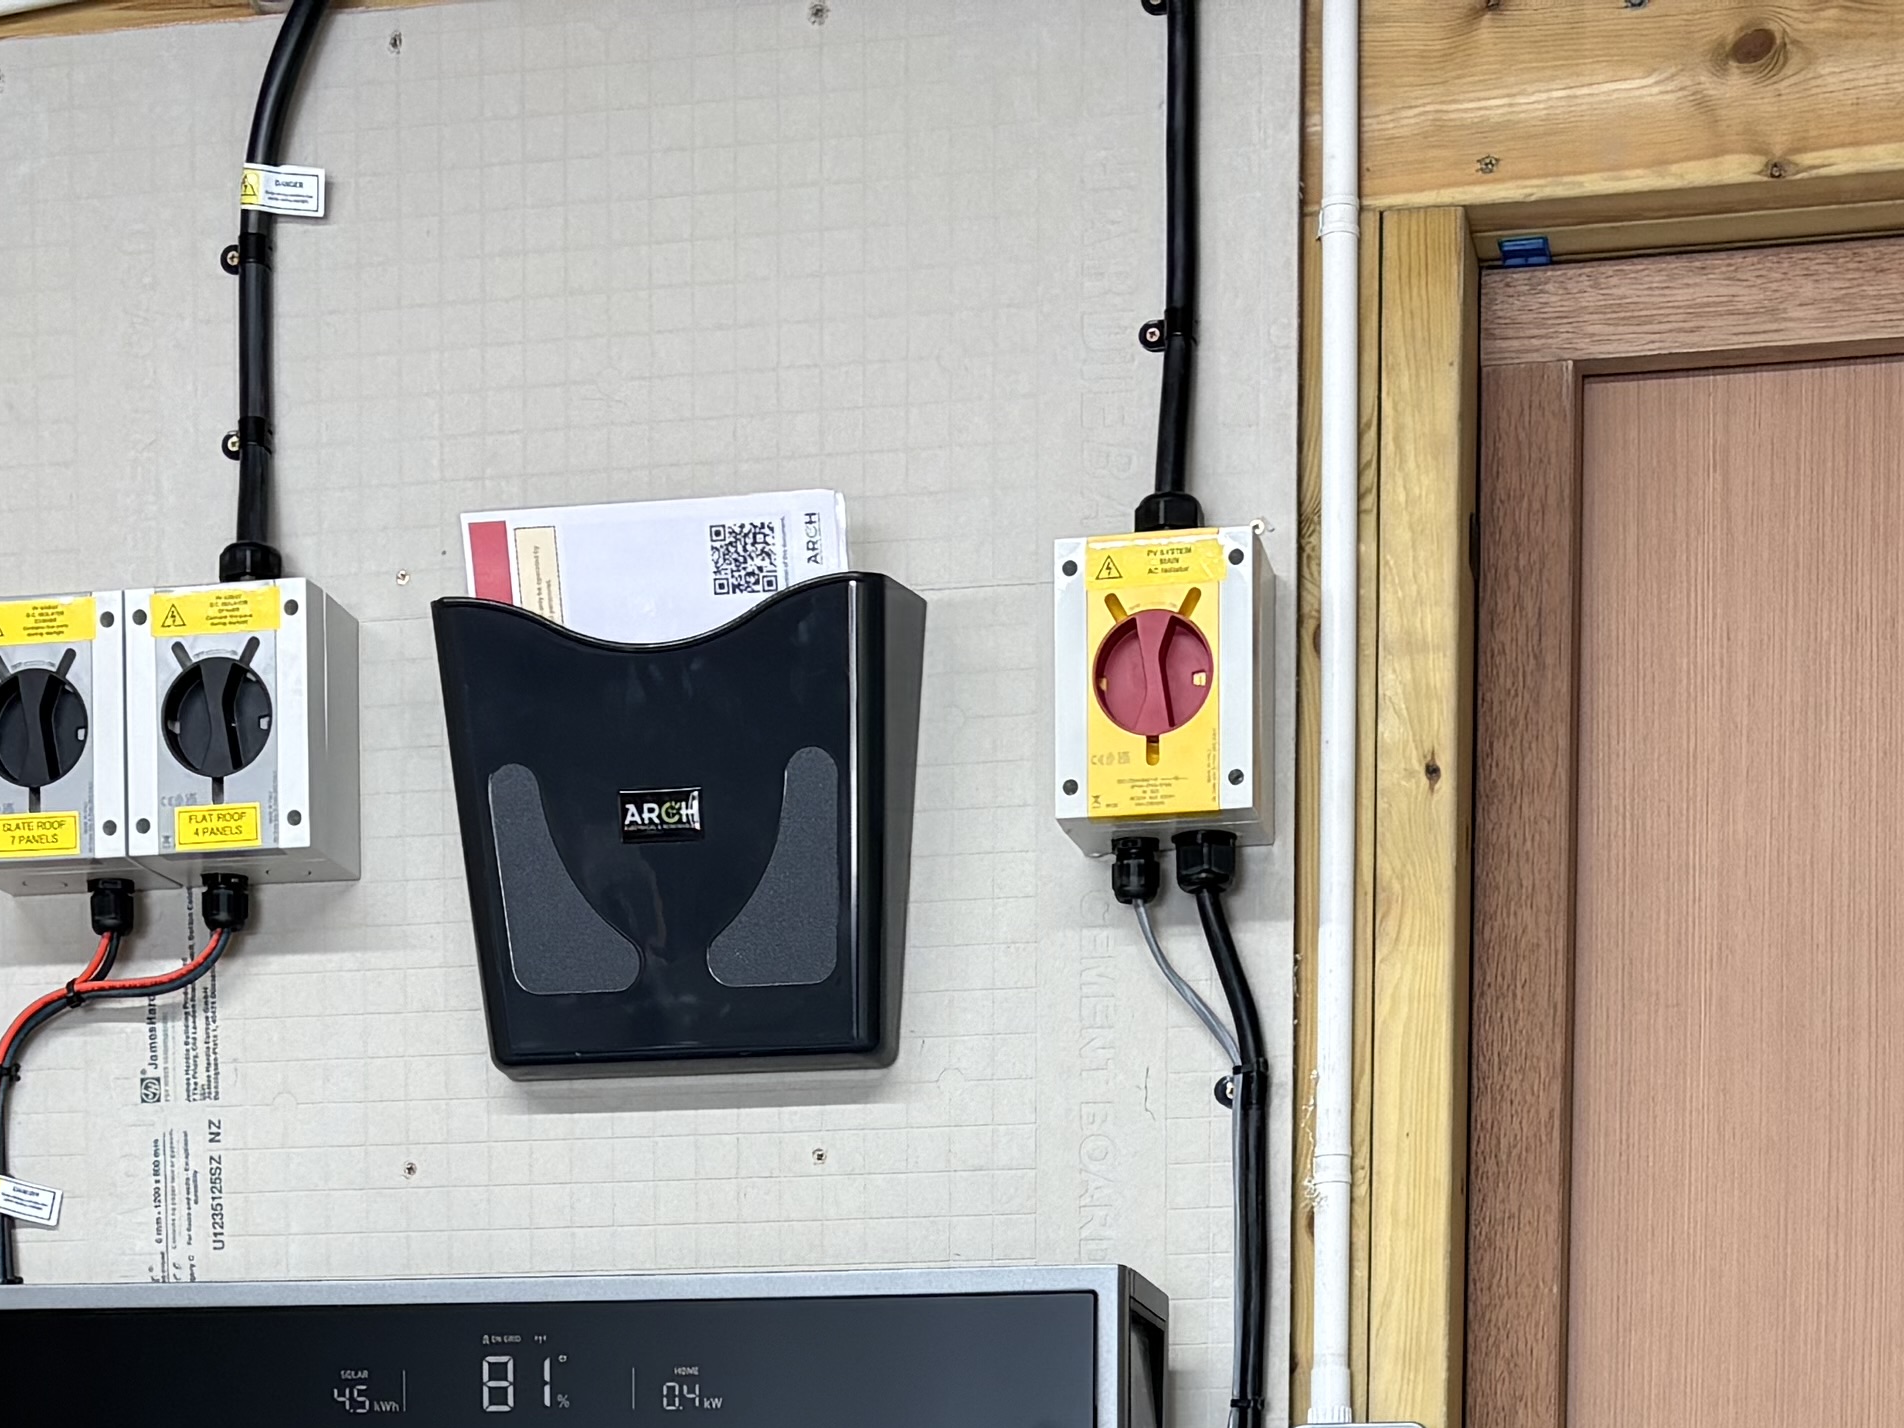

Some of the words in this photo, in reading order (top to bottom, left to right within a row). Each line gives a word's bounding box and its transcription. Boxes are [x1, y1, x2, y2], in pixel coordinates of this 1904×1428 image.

[804, 513, 820, 564] ARCH
[189, 814, 213, 824] FLAT
[217, 812, 246, 821] ROOF
[624, 801, 700, 825] ARCH
[2, 821, 33, 832] SLATE
[37, 820, 66, 830] ROOF
[194, 828, 199, 837] 4
[203, 825, 242, 836] PANELS
[10, 836, 16, 845] 7
[19, 834, 59, 844] PANELS
[208, 1119, 221, 1143] NZ
[209, 1155, 225, 1250] U1235125SZ
[341, 1370, 369, 1379] SOLAR
[674, 1366, 699, 1375] HOME
[482, 1356, 551, 1412] 81
[663, 1382, 699, 1410] 0.4
[704, 1398, 722, 1409] kW
[374, 1401, 399, 1411] kWh
